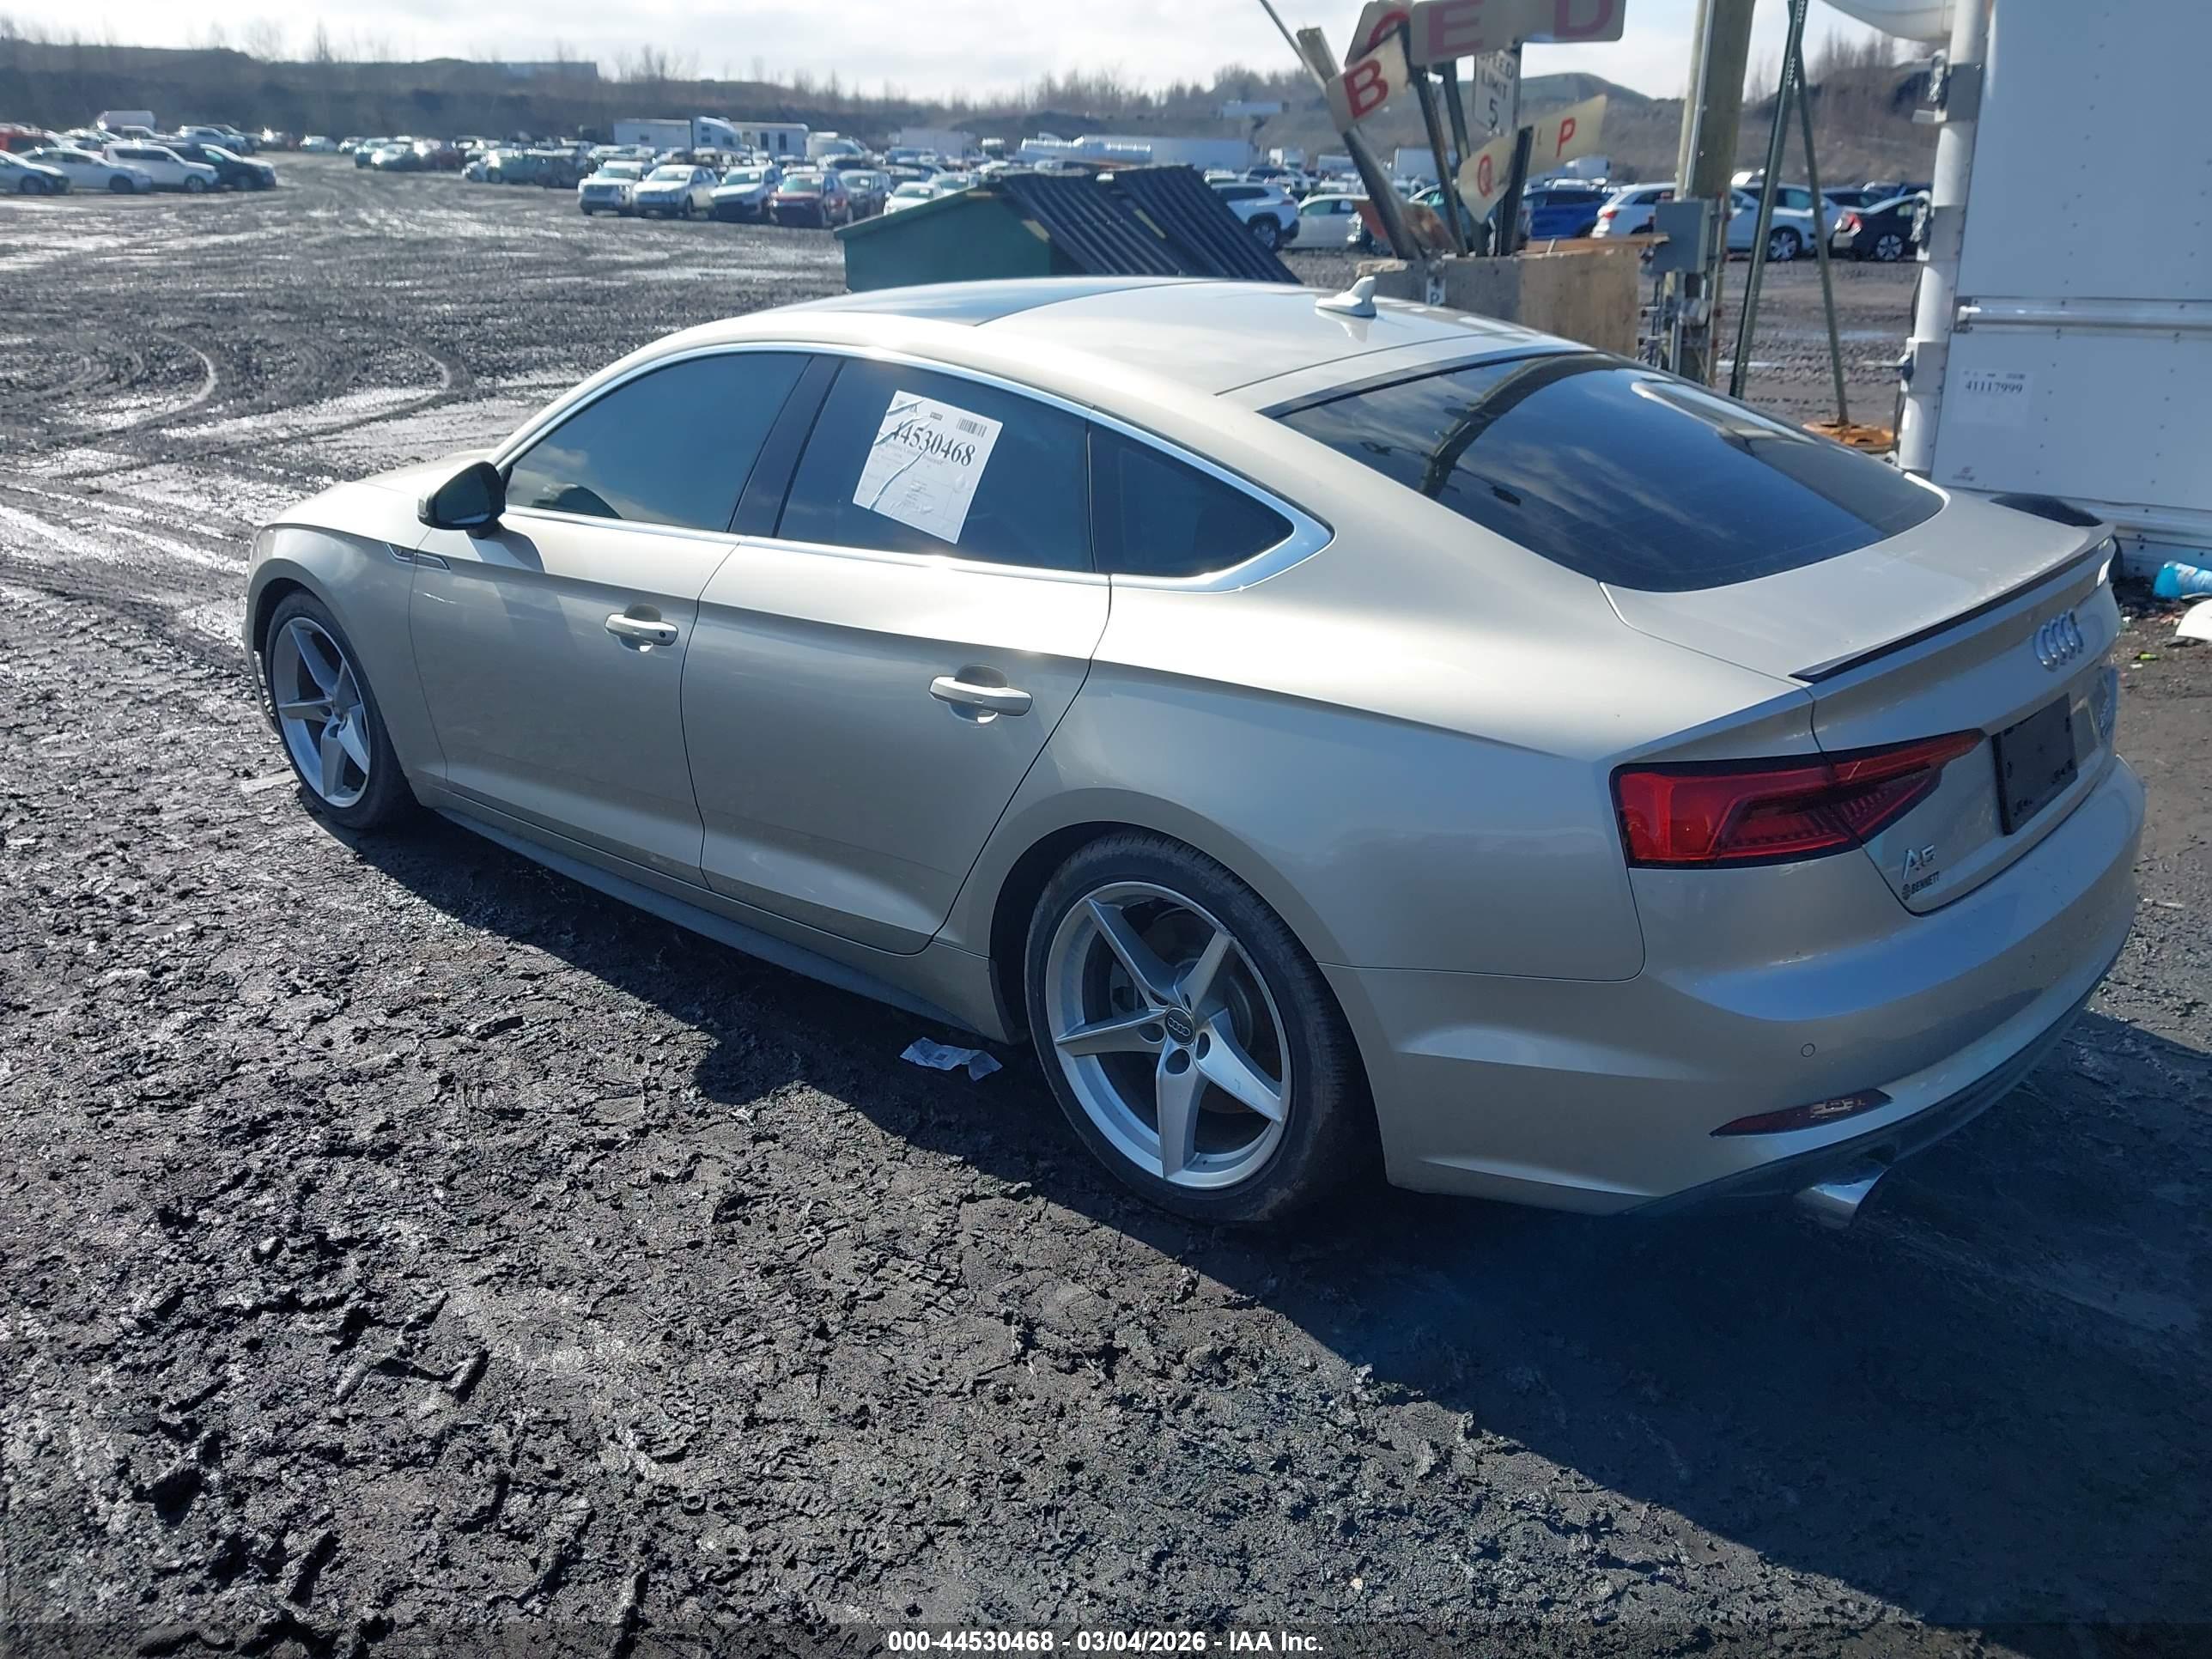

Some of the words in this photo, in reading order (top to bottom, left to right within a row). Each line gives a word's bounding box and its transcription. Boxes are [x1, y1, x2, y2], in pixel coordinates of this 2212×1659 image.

[1427, 0, 1484, 58] E
[1343, 59, 1389, 118] B
[1488, 98, 1498, 129] 5
[1556, 117, 1577, 158] P
[1478, 155, 1493, 198] Q
[893, 422, 975, 466] 44530468
